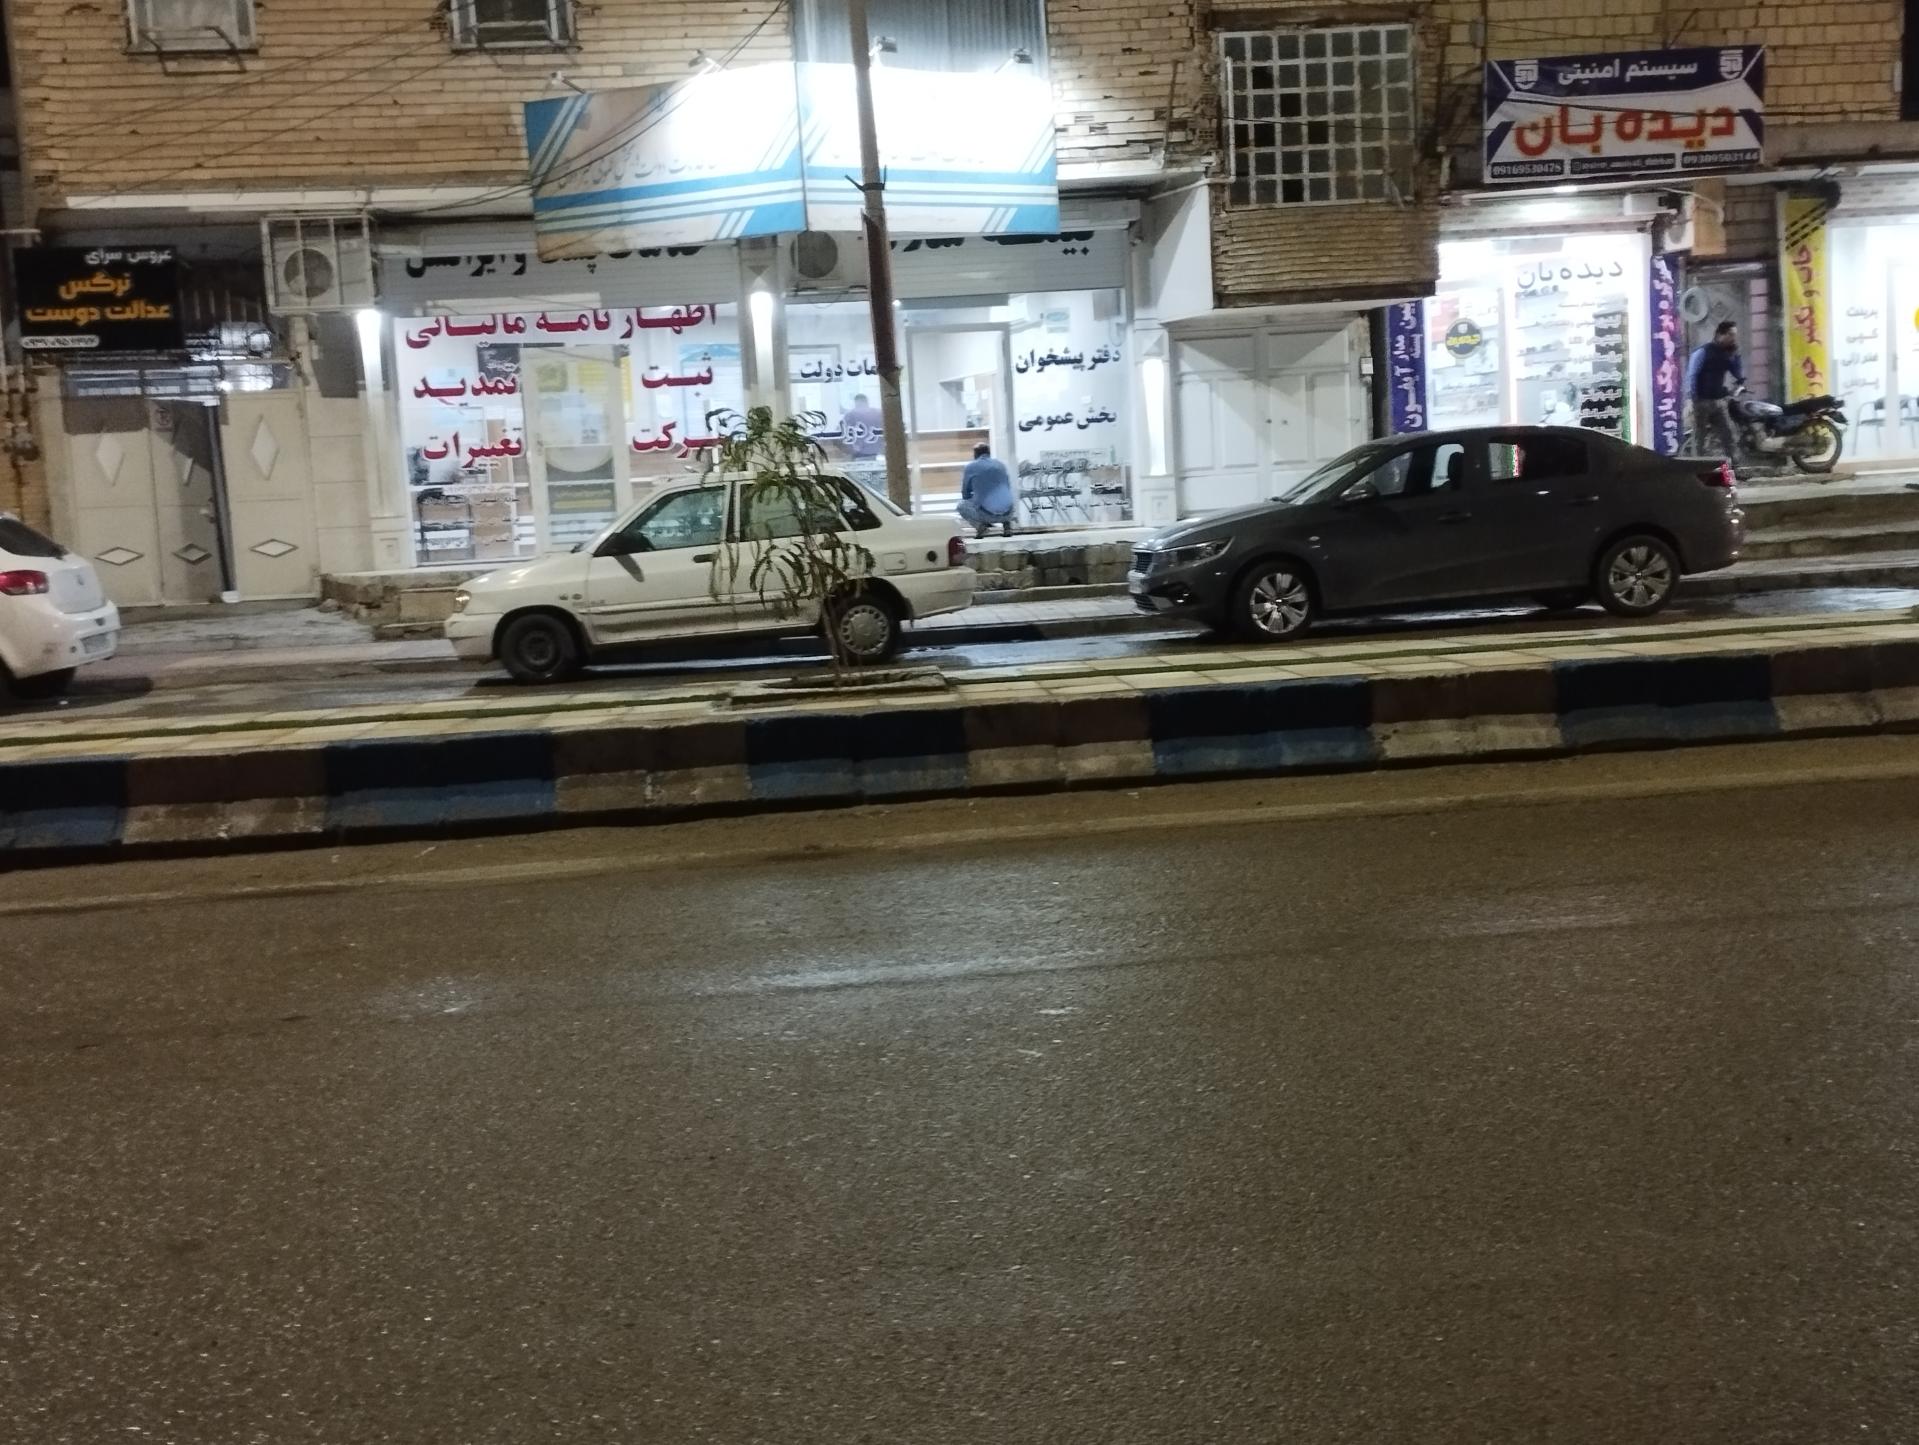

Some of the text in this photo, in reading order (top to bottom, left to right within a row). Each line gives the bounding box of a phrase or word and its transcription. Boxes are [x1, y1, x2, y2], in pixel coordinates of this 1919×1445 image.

[1558, 58, 1620, 86] امنیتی
[1625, 62, 1698, 83] سیستم
[1515, 104, 1736, 157] دیده بان
[58, 269, 133, 299] نرگس
[1516, 260, 1624, 290] دیده بان
[25, 299, 173, 327] عدالت دوست
[405, 303, 718, 349] اظهار نامه مالیاتی
[641, 352, 714, 396] ثبت
[800, 358, 878, 383] مات دولت
[1015, 345, 1121, 374] دفتر پیشخوان
[413, 361, 521, 407] تمدید
[1018, 406, 1117, 432] بخش عمومی
[423, 426, 526, 470] تغییرات
